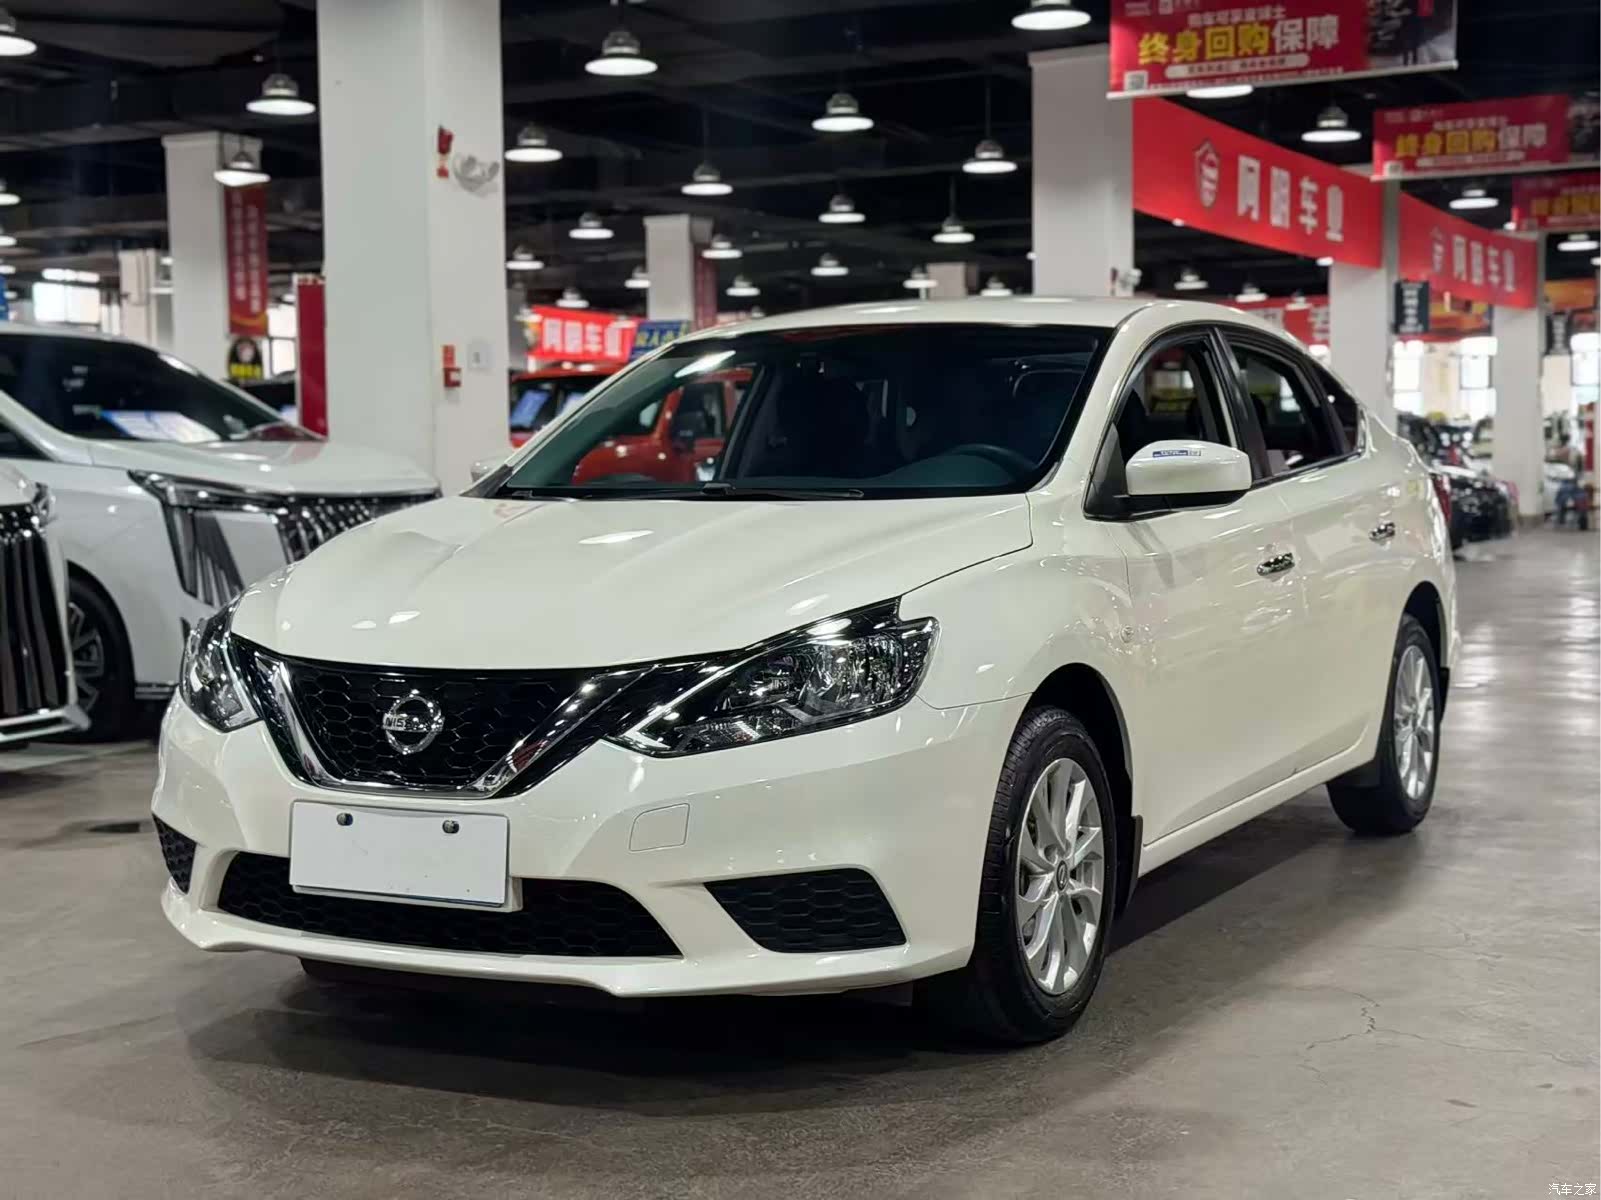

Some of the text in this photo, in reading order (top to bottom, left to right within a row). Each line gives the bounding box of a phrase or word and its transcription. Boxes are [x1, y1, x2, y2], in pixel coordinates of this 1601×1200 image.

[1138, 15, 1340, 65] 终身回购保障
